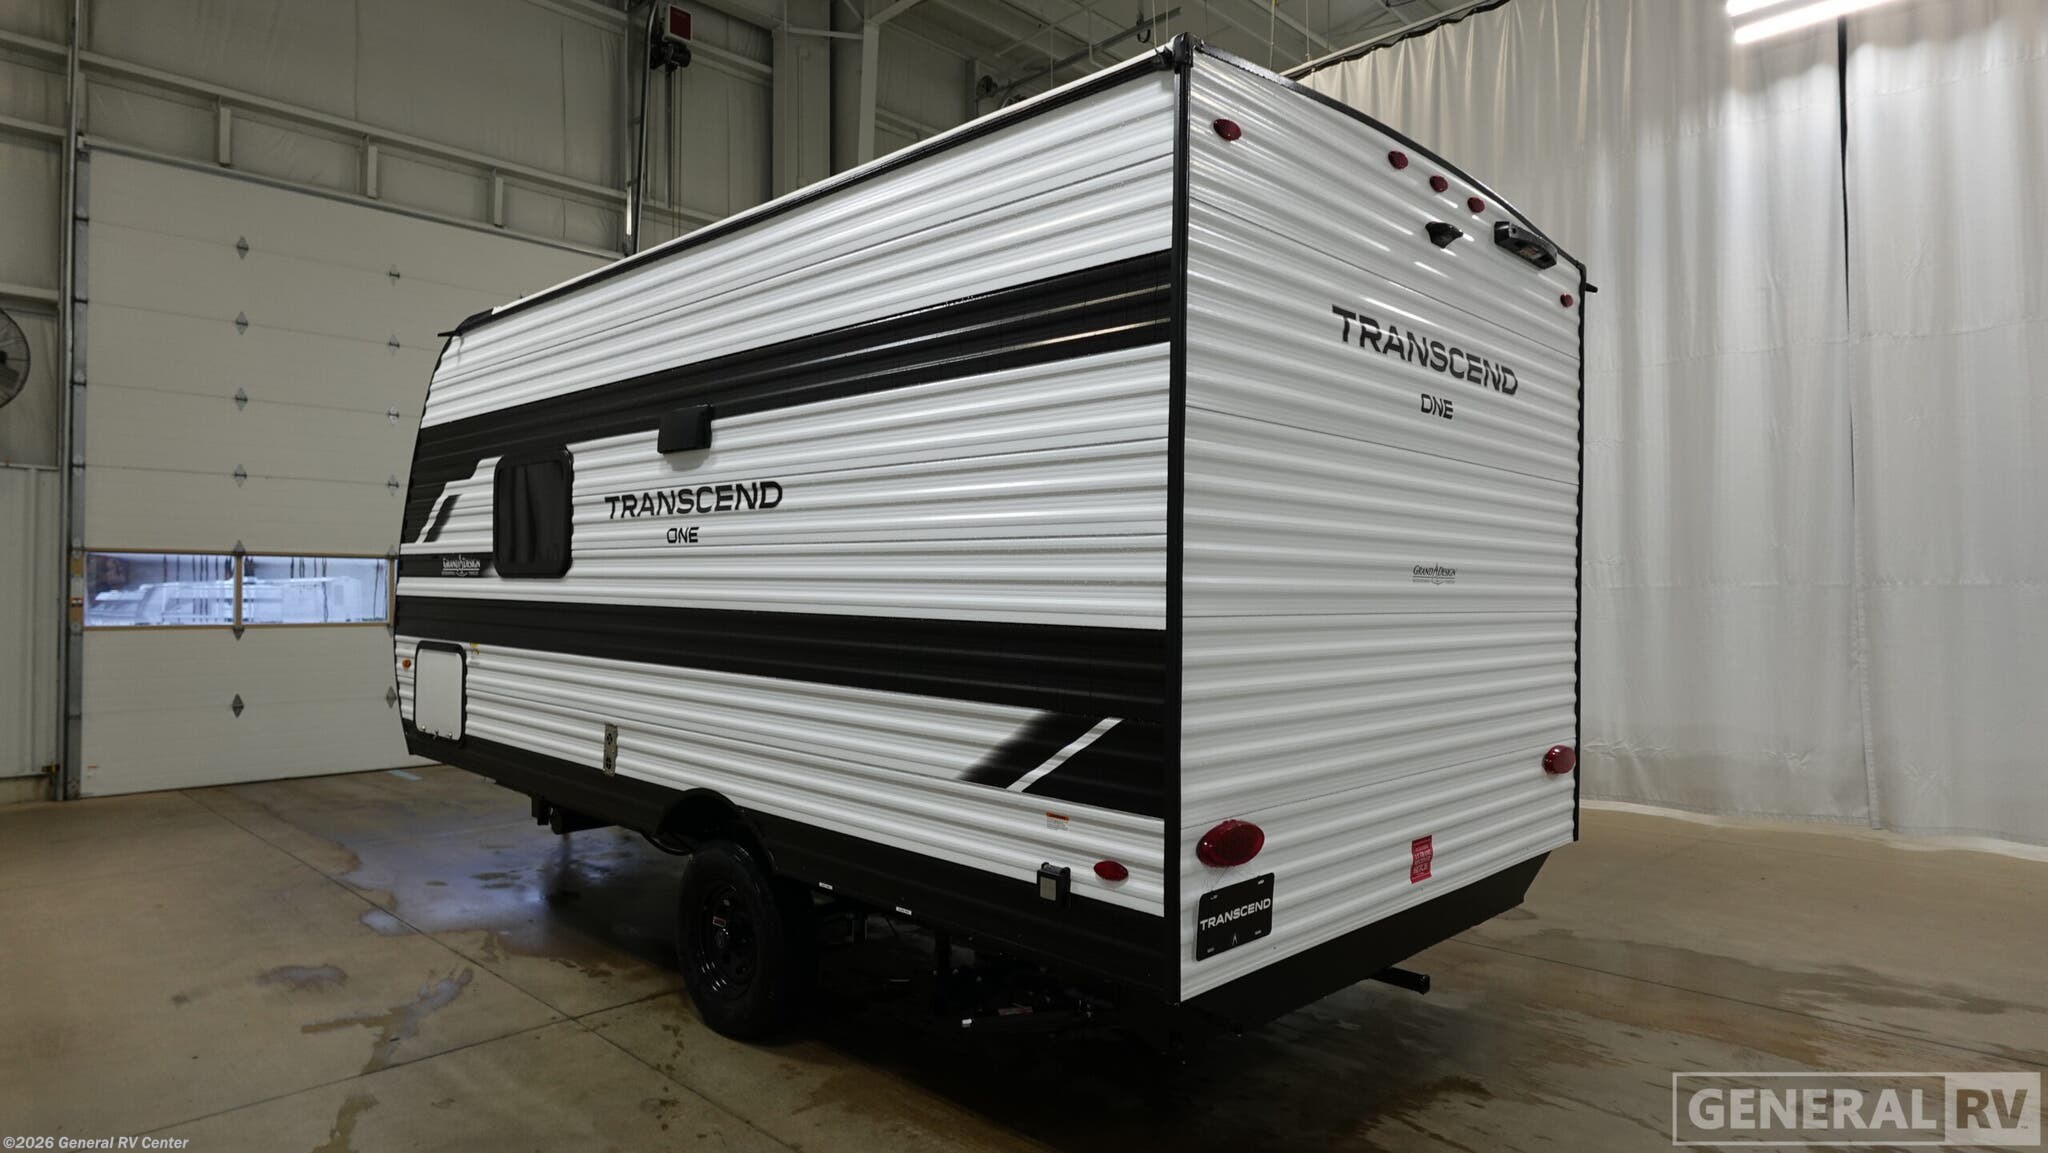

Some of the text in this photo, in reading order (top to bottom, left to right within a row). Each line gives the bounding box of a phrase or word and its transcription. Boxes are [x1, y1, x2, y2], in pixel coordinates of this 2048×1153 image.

[1331, 304, 1519, 396] TRANSCEND
[604, 480, 783, 520] TRANSCEND
[666, 526, 700, 544] ONE
[1199, 897, 1272, 931] TRANSCEND
